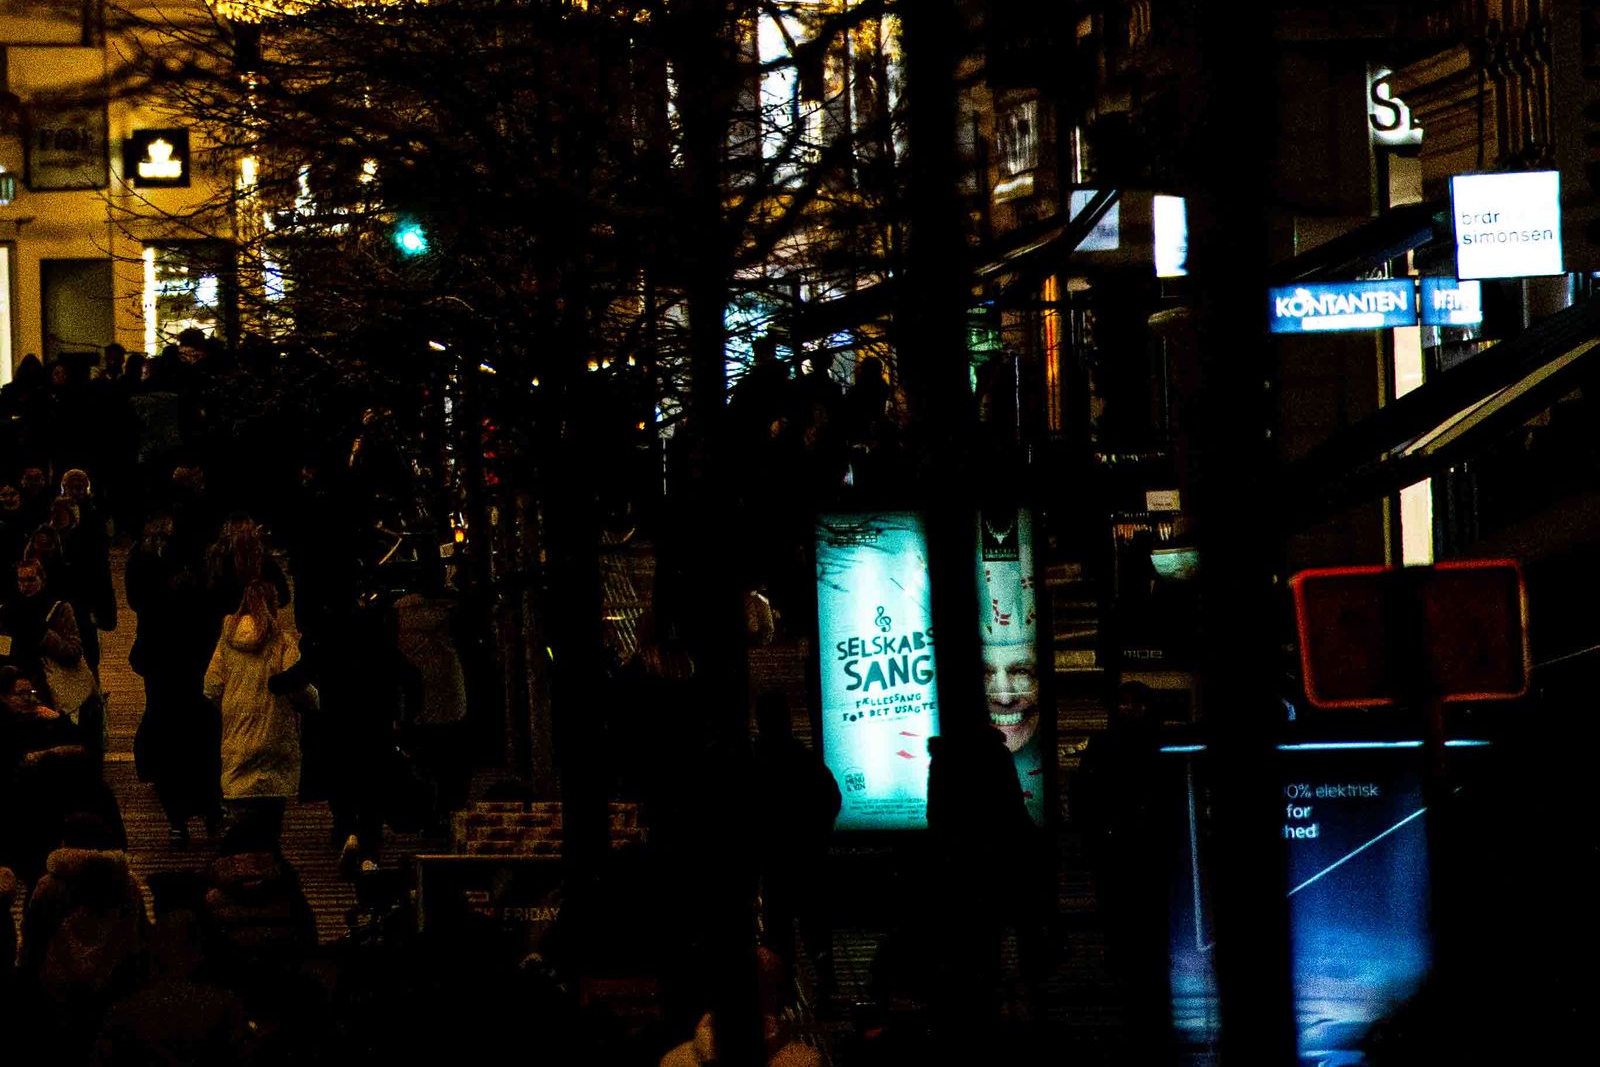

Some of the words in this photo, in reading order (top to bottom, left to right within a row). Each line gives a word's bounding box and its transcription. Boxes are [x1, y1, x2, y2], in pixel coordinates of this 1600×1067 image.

[1462, 211, 1500, 226] brdr
[1463, 229, 1553, 245] simonsen
[1275, 290, 1408, 318] KONTANTEN
[837, 627, 935, 660] SELSKABS
[844, 655, 935, 692] SANG
[856, 693, 922, 708] FÆLLESSANG
[869, 708, 889, 718] DET
[894, 701, 937, 714] USAGTE
[1315, 782, 1380, 798] elektrisk
[1286, 803, 1313, 819] for
[503, 907, 561, 921] FRIDAY
